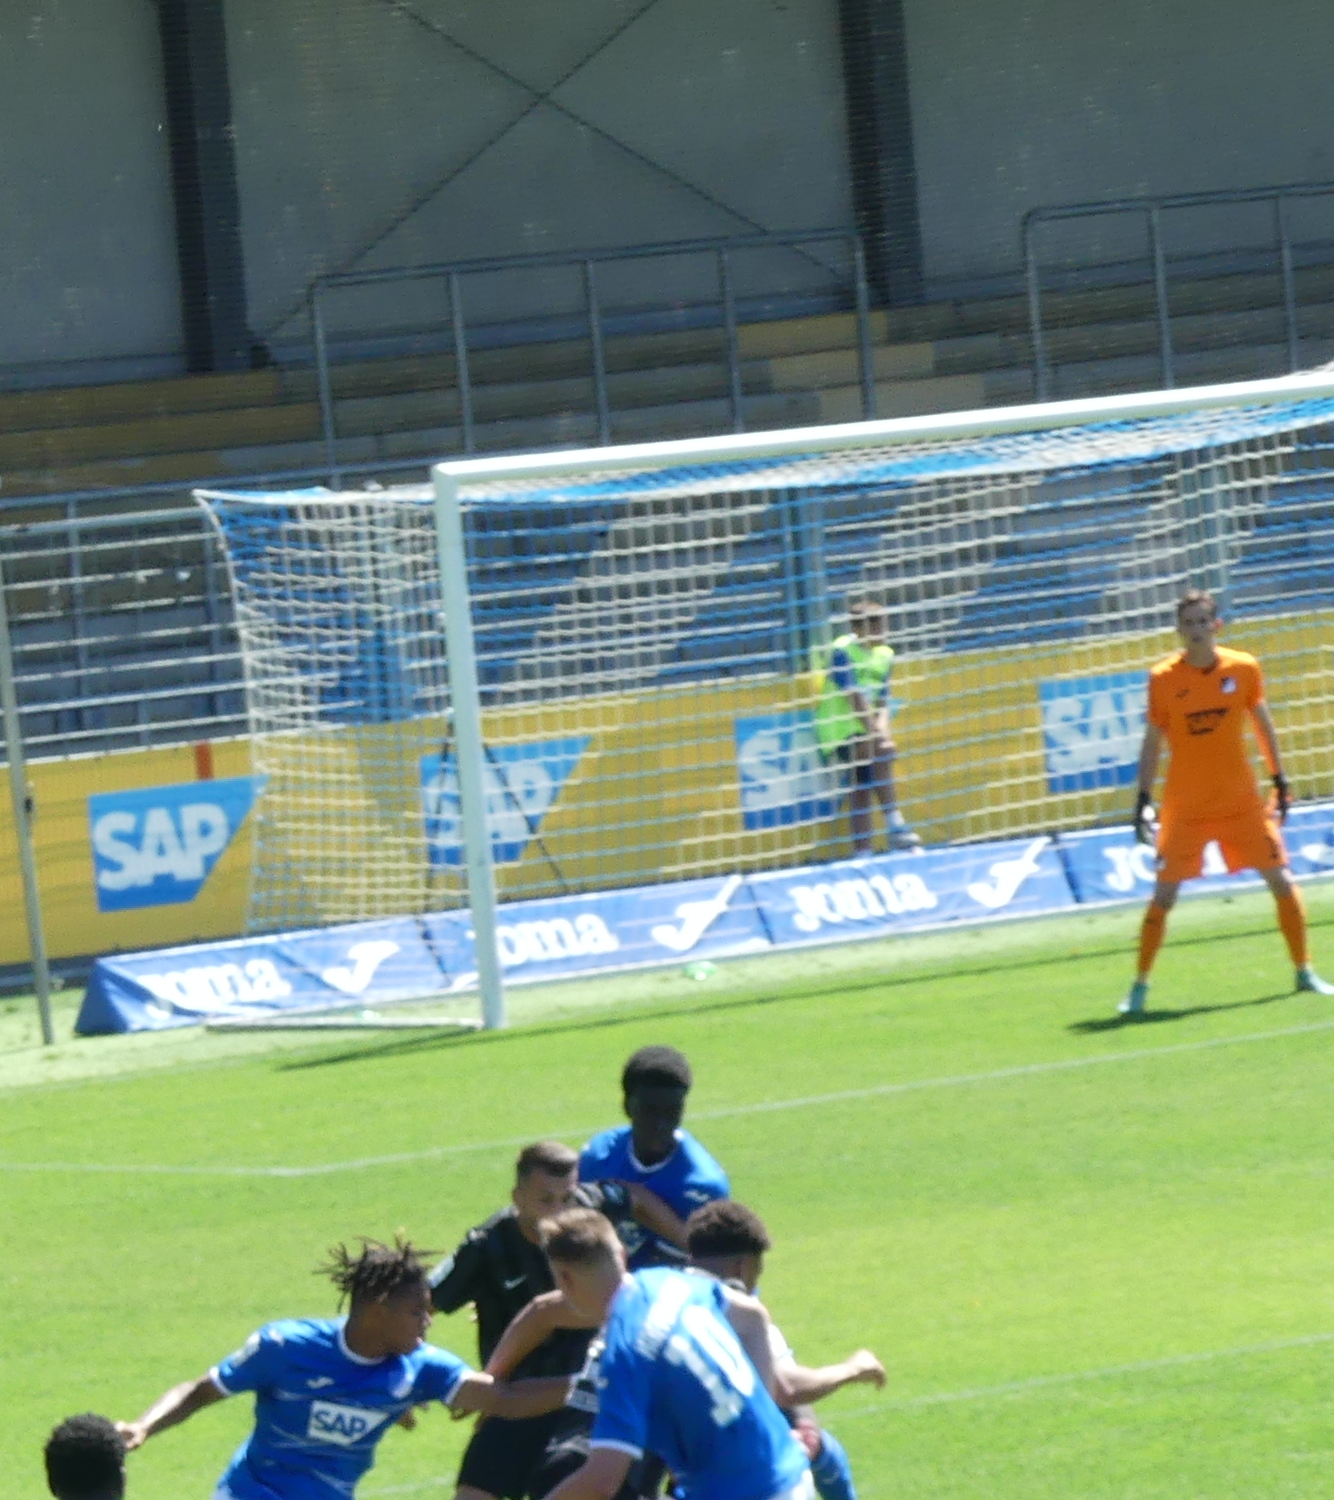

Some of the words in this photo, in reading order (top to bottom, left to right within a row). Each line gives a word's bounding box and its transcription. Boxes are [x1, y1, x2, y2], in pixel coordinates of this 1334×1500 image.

[94, 802, 230, 890] SAP
[465, 914, 621, 966] oma
[314, 1410, 368, 1437] SAP
